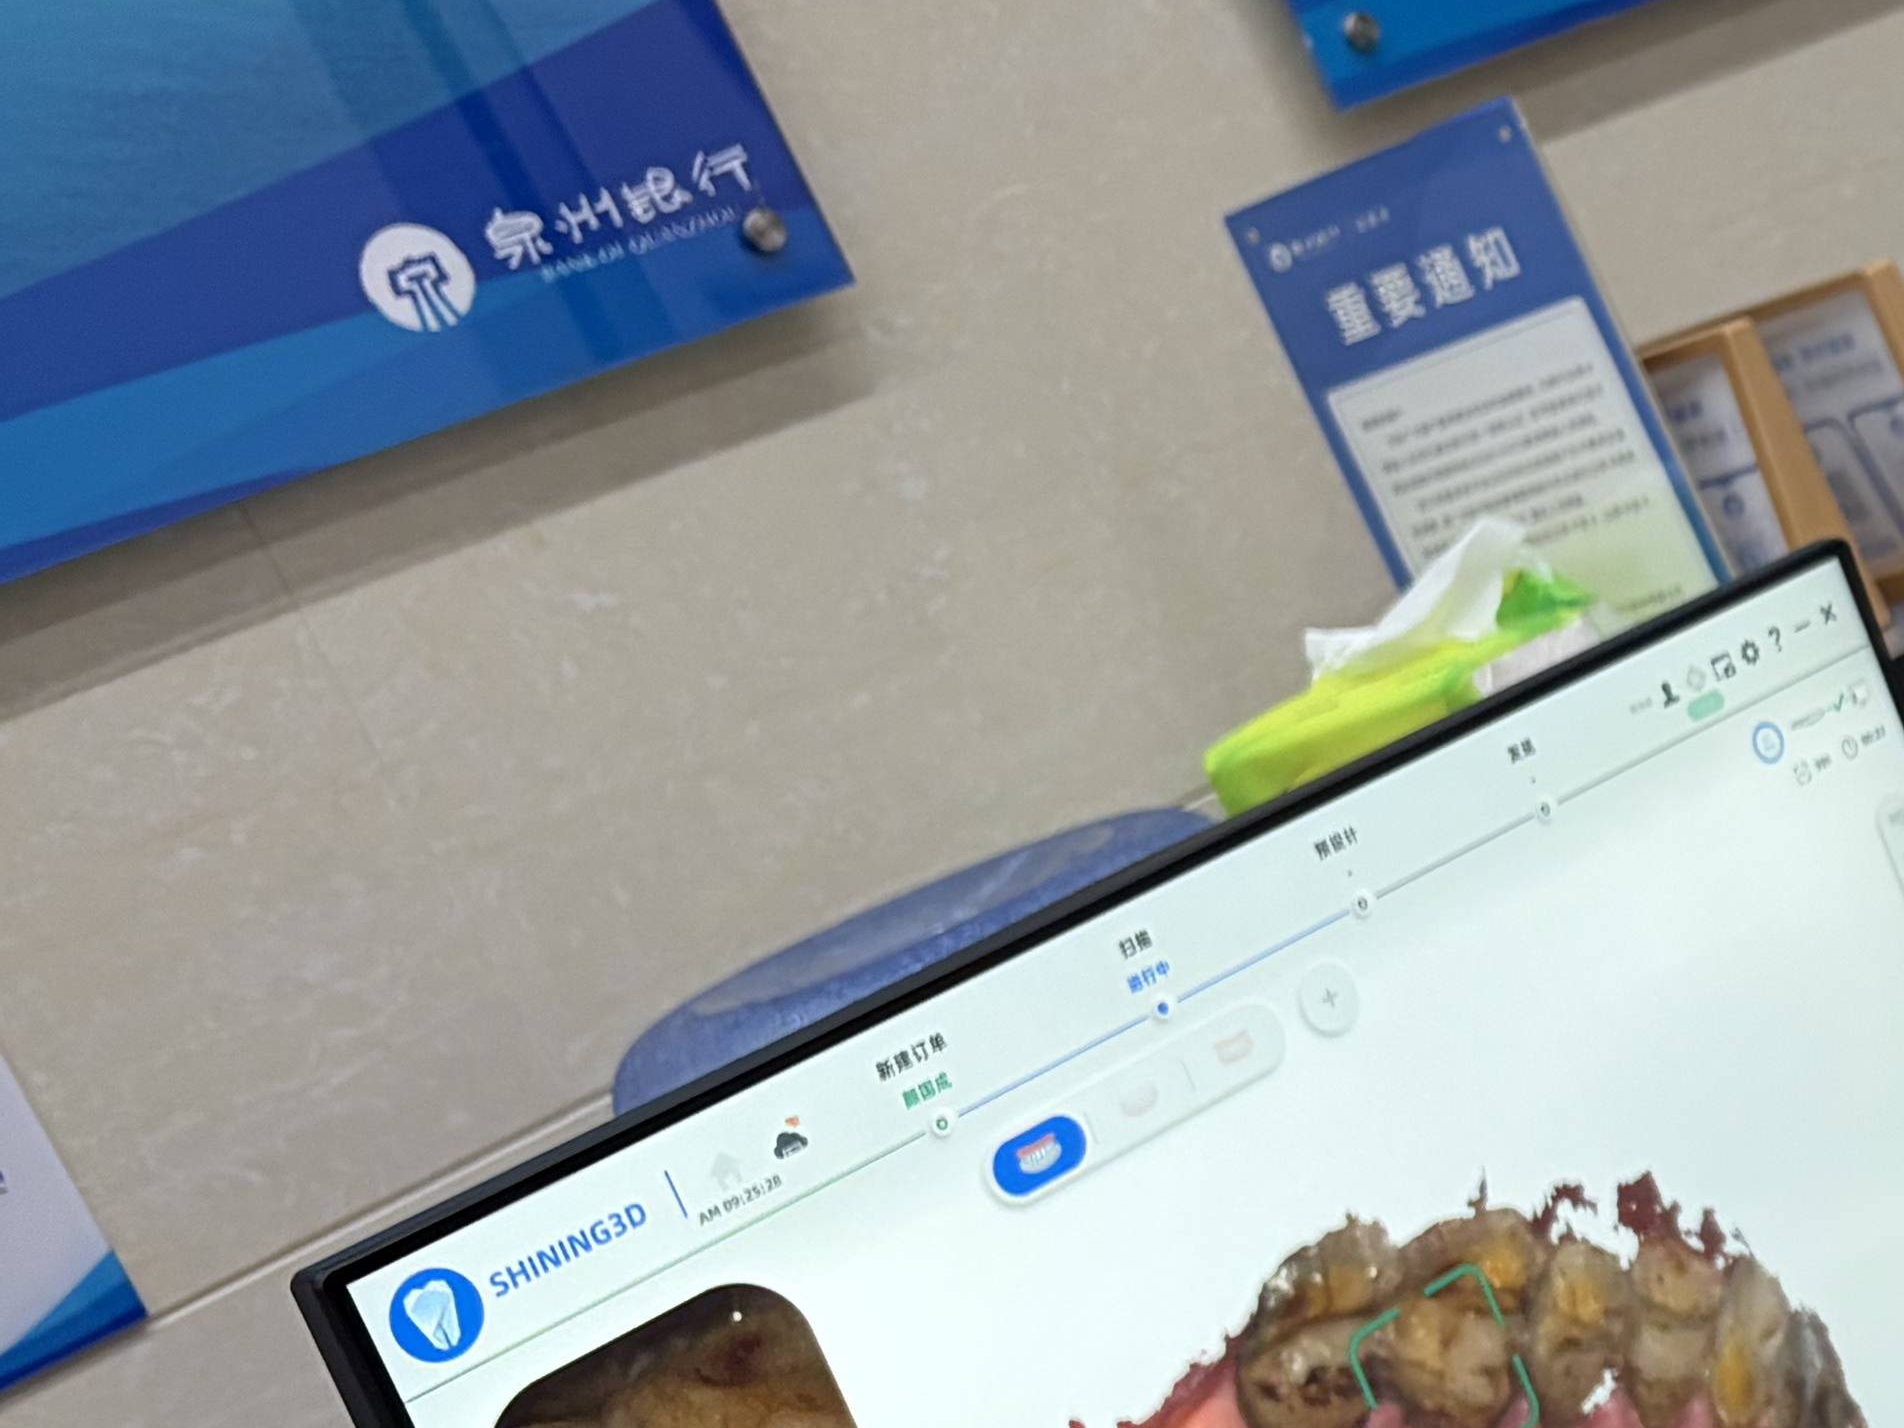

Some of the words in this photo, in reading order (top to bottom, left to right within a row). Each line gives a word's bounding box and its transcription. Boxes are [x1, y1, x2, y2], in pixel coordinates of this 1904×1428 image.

[485, 144, 752, 270] 泉州银行
[1325, 224, 1521, 347] 重要通知
[1118, 929, 1153, 960] 扫描
[875, 1032, 948, 1082] 新建订单
[489, 1203, 647, 1298] SHINING3D
[698, 1203, 722, 1227] AM
